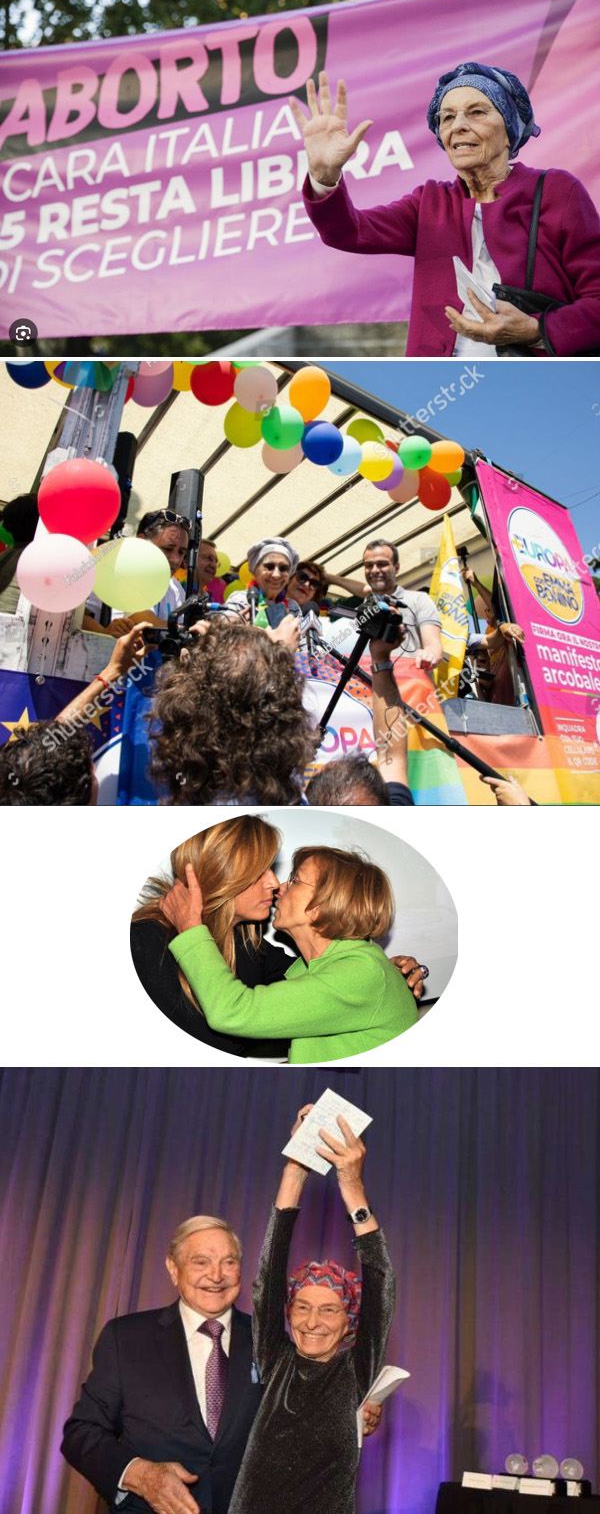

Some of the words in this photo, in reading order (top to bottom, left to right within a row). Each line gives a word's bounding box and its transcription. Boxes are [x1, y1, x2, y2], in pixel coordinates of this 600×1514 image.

[0, 15, 317, 150] ABORTO
[3, 141, 131, 203] CARA
[145, 104, 302, 173] ITALIA
[36, 175, 197, 244] RESTA
